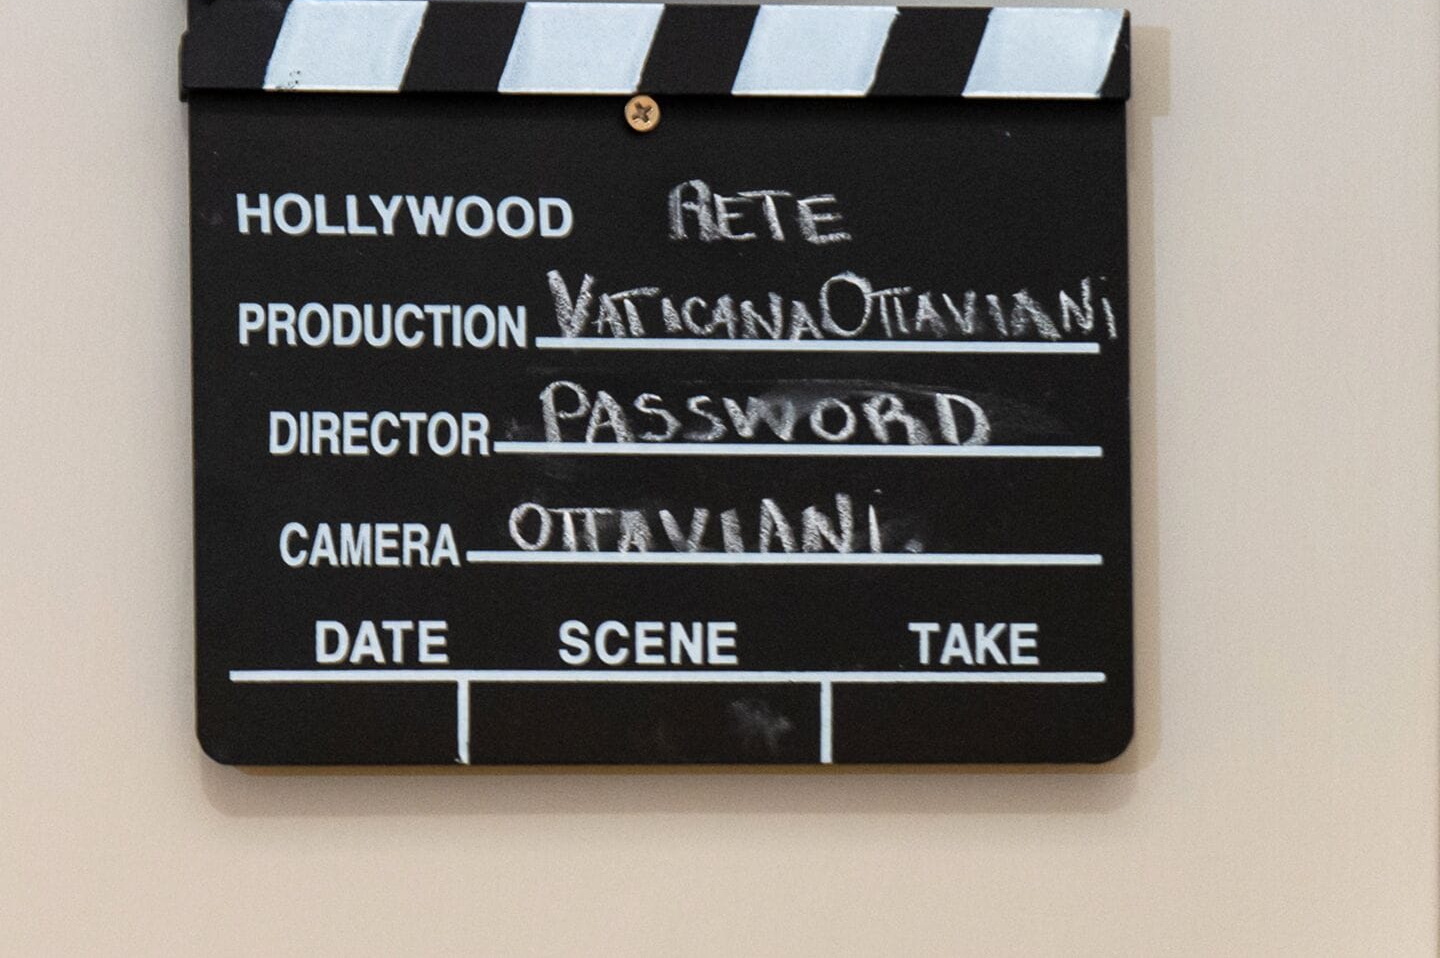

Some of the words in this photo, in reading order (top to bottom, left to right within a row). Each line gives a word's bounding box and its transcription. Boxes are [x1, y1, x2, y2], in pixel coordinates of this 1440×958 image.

[236, 192, 574, 239] HOLLYWOOD
[668, 178, 853, 246] RETE
[238, 301, 528, 349] PRODUCTION
[268, 411, 491, 458] DIRECTOR
[539, 380, 992, 445] PASSWORD
[279, 522, 461, 568] CAMERA
[315, 620, 449, 665] DATE
[557, 619, 739, 666] SCENE
[908, 622, 1040, 666] TAKE
